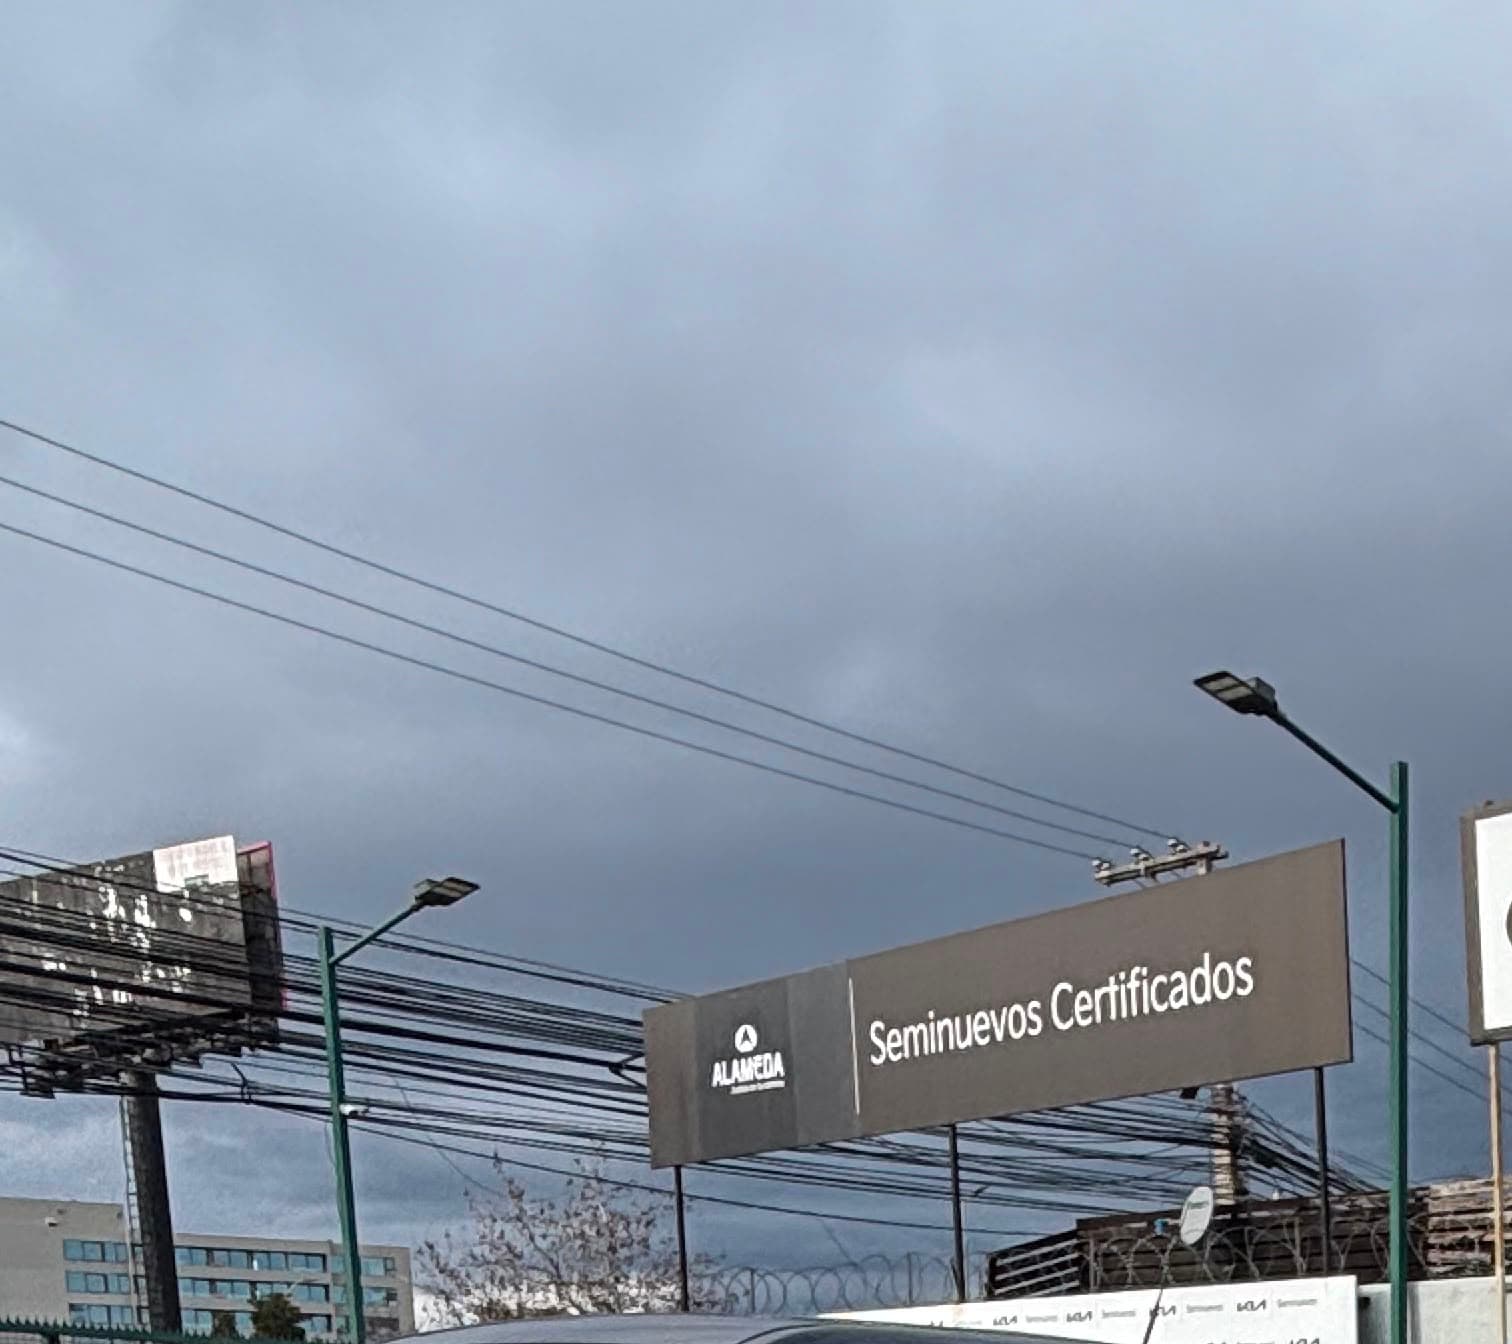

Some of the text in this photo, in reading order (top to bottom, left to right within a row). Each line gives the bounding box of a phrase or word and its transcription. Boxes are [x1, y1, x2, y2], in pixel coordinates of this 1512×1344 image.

[869, 951, 1254, 1066] Seminuevos Certificados
[711, 1051, 786, 1088] ALAMEDA
